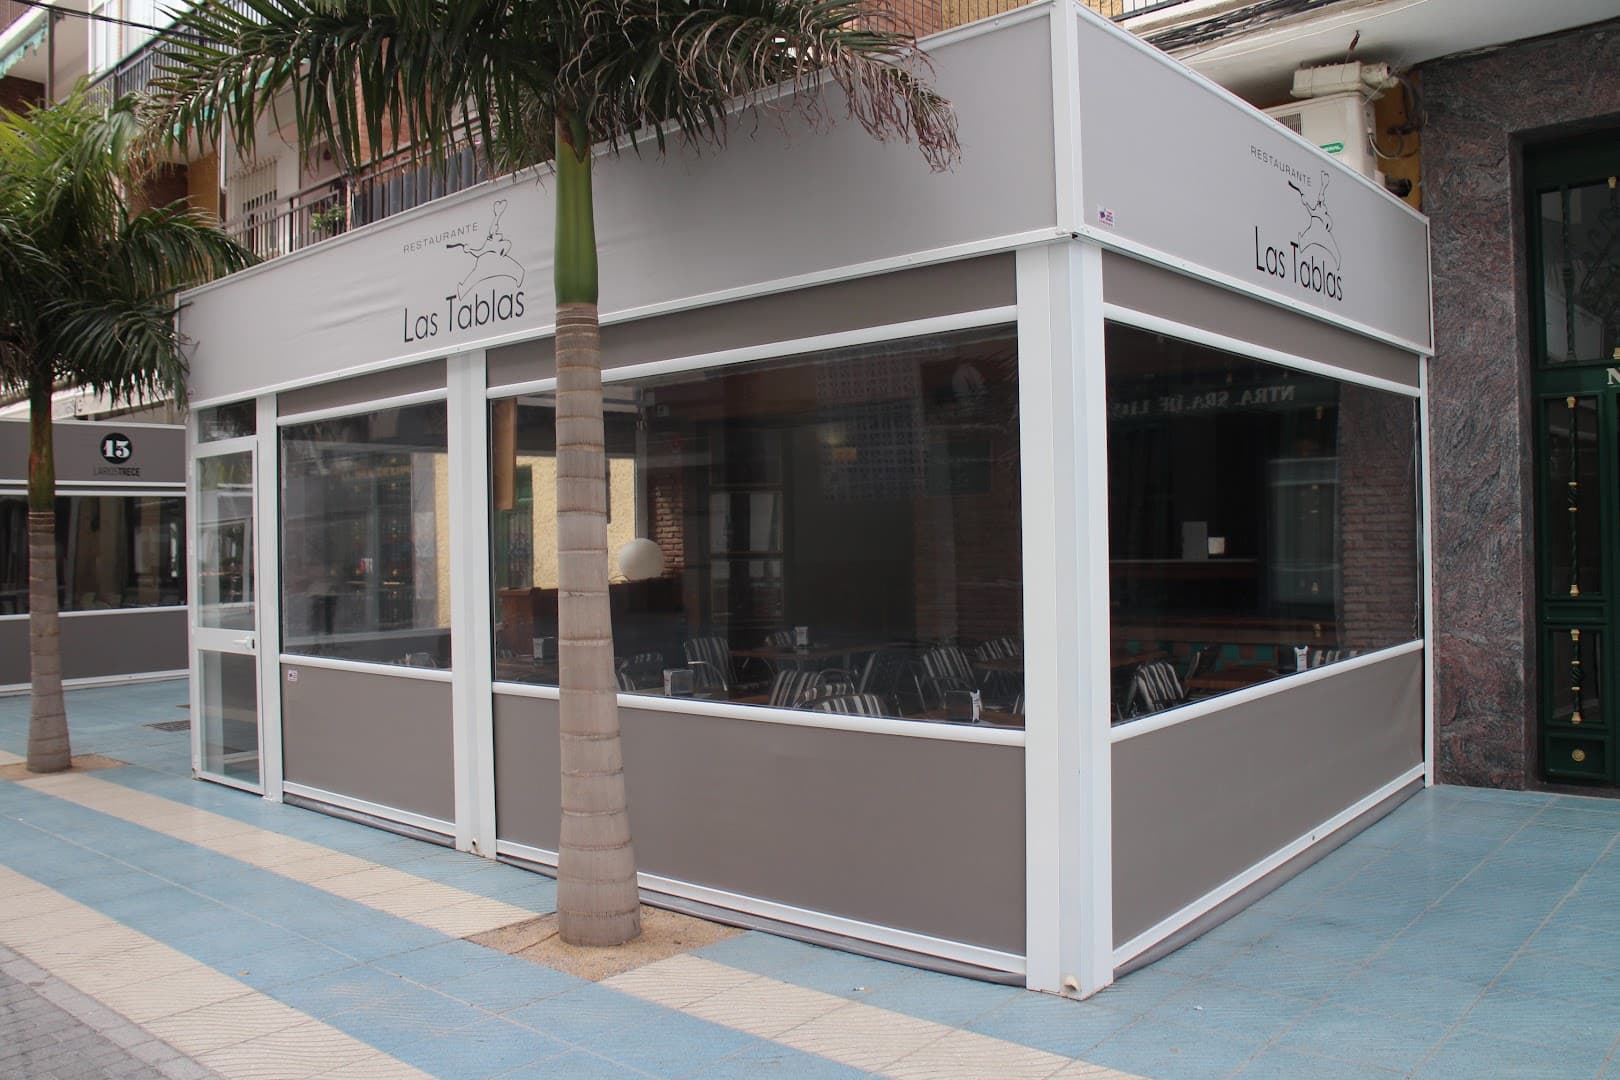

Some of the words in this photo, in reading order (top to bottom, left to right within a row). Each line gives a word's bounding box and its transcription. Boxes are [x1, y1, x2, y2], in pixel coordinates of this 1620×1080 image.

[1250, 145, 1313, 188] RESTAURANTE
[402, 222, 480, 255] RESTAURANTE
[1255, 225, 1286, 279] Las
[1290, 241, 1343, 301] Tablas
[404, 307, 439, 343] Las
[445, 288, 525, 332] Tablas
